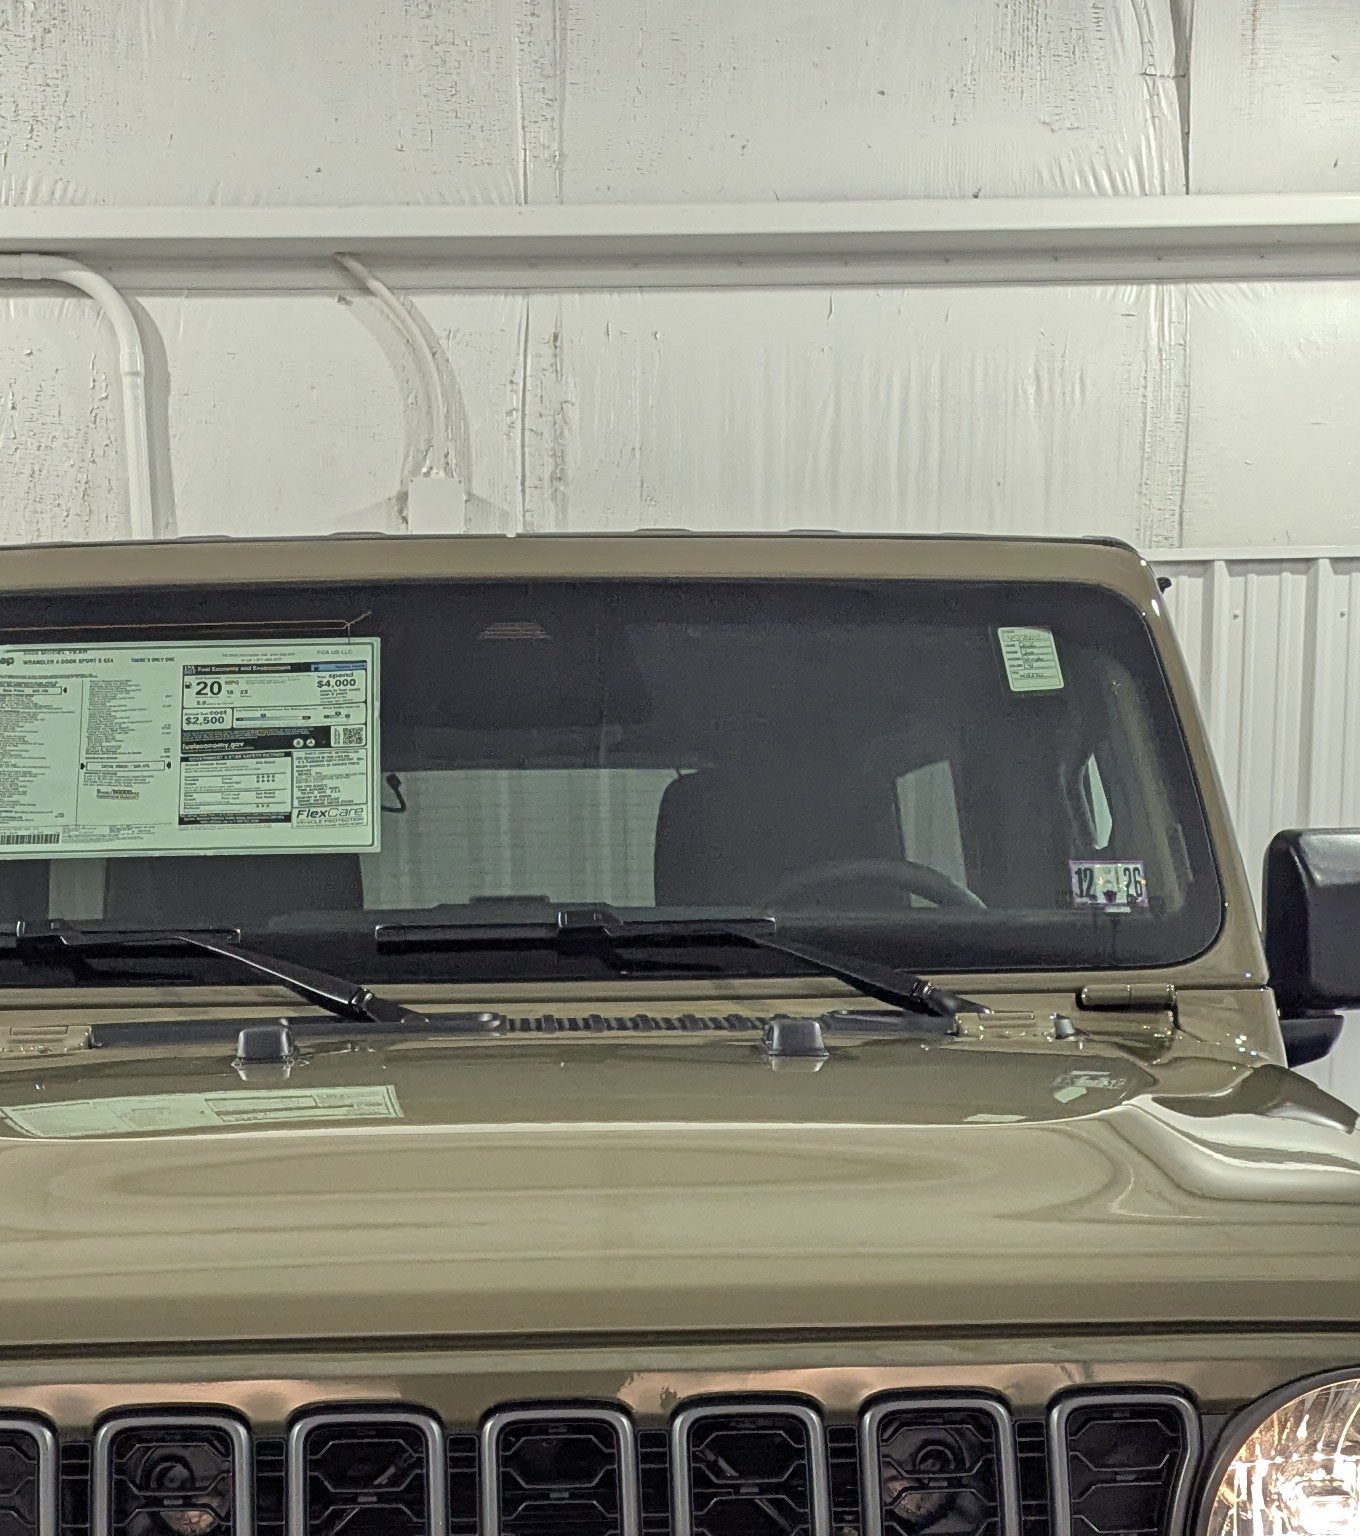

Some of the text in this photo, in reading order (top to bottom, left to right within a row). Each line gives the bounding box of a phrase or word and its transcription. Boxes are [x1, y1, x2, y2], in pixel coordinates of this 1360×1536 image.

[195, 680, 223, 696] 20
[316, 678, 357, 689] $4,000
[185, 716, 225, 726] $2,500
[182, 742, 245, 750] fueleconomy.gov
[296, 807, 364, 819] FlexCare
[1074, 867, 1097, 900] 12
[1123, 866, 1144, 899] 26
